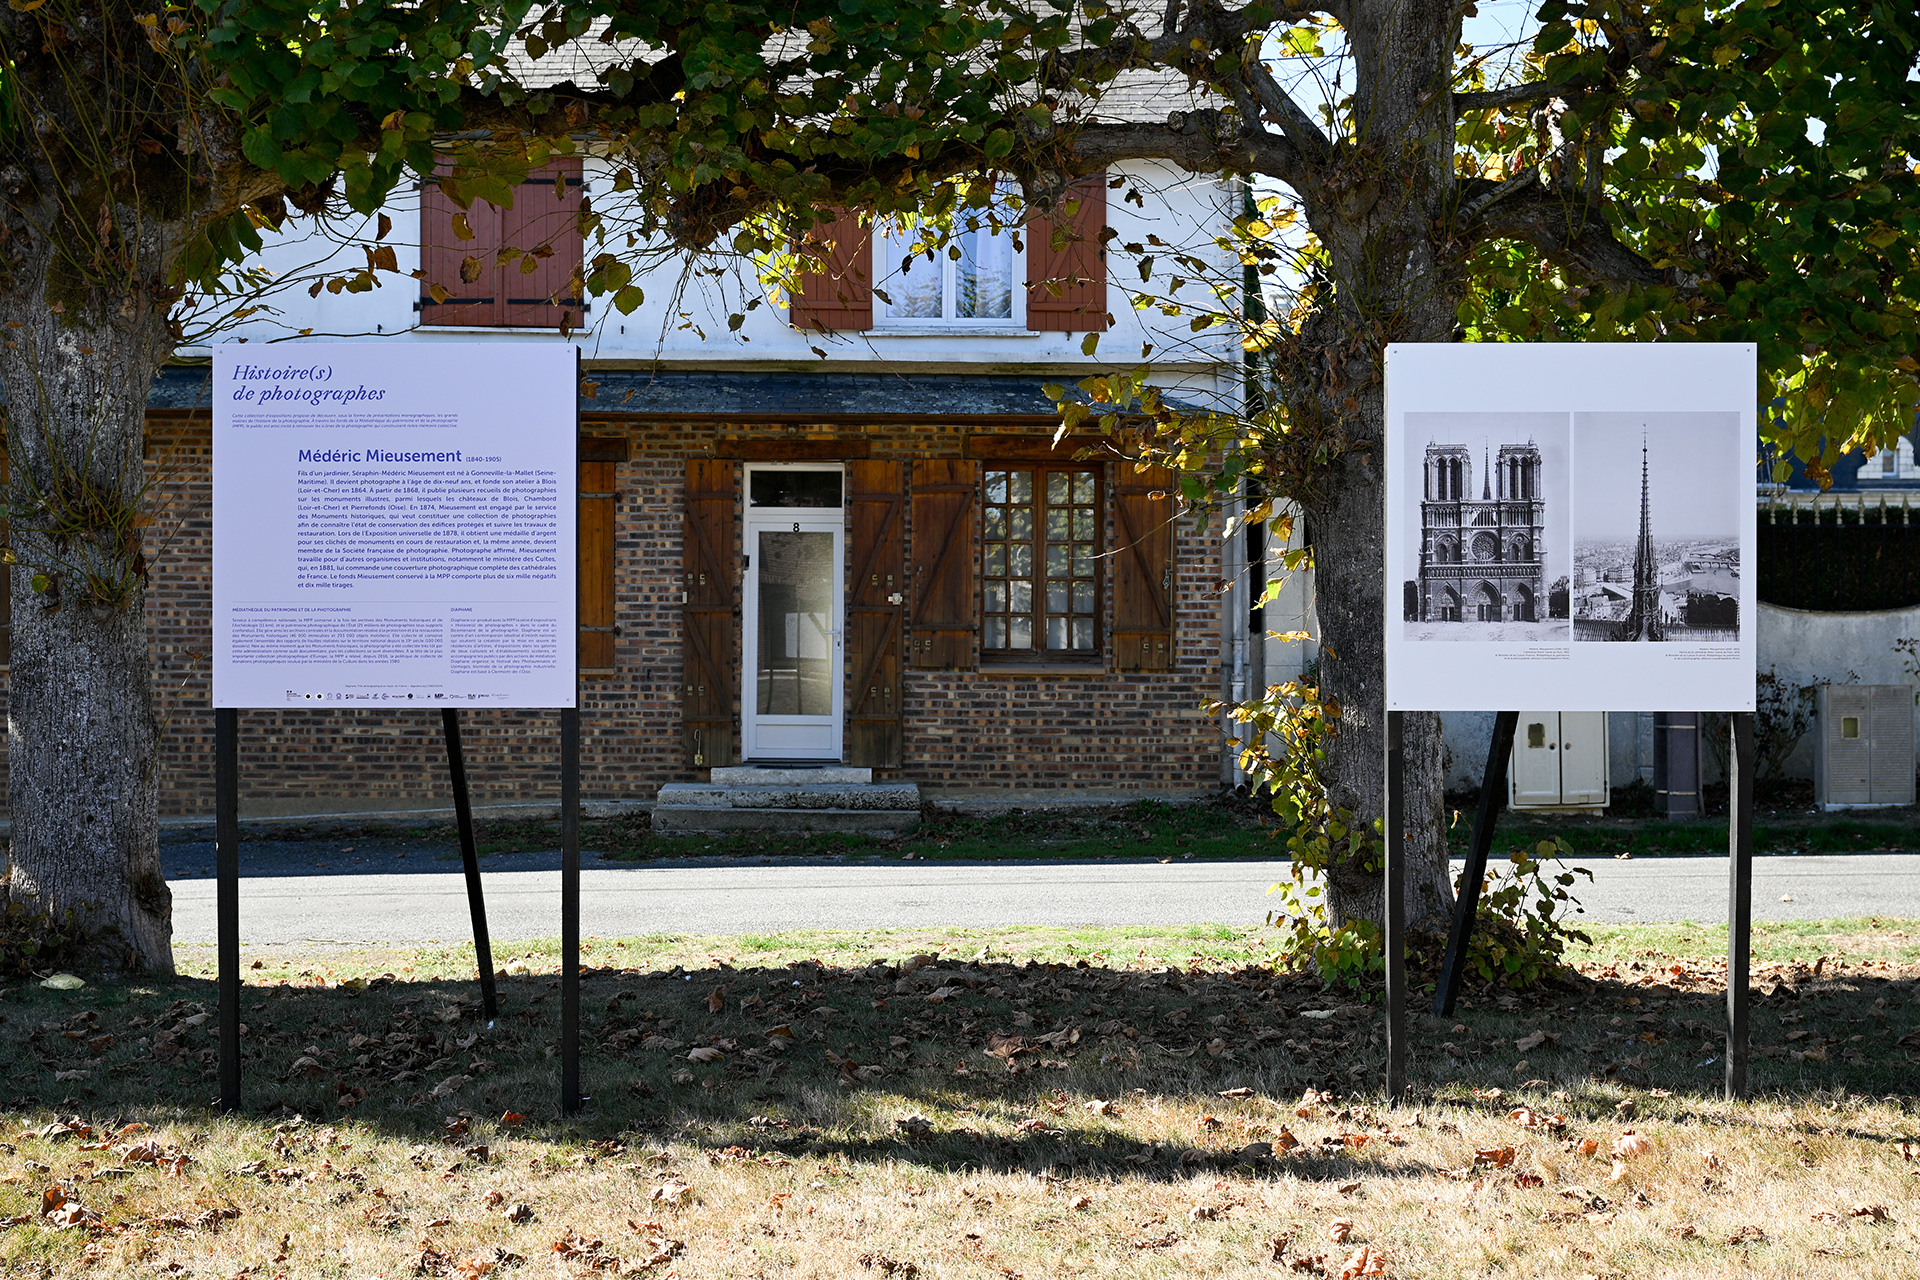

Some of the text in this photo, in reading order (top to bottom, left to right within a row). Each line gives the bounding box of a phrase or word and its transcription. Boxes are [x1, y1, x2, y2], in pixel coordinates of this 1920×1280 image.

[232, 365, 332, 382] Histoire(s)
[233, 385, 386, 406] de photographes
[298, 449, 361, 462] Médéric
[366, 449, 462, 462] Mieusement
[793, 522, 800, 532] 8
